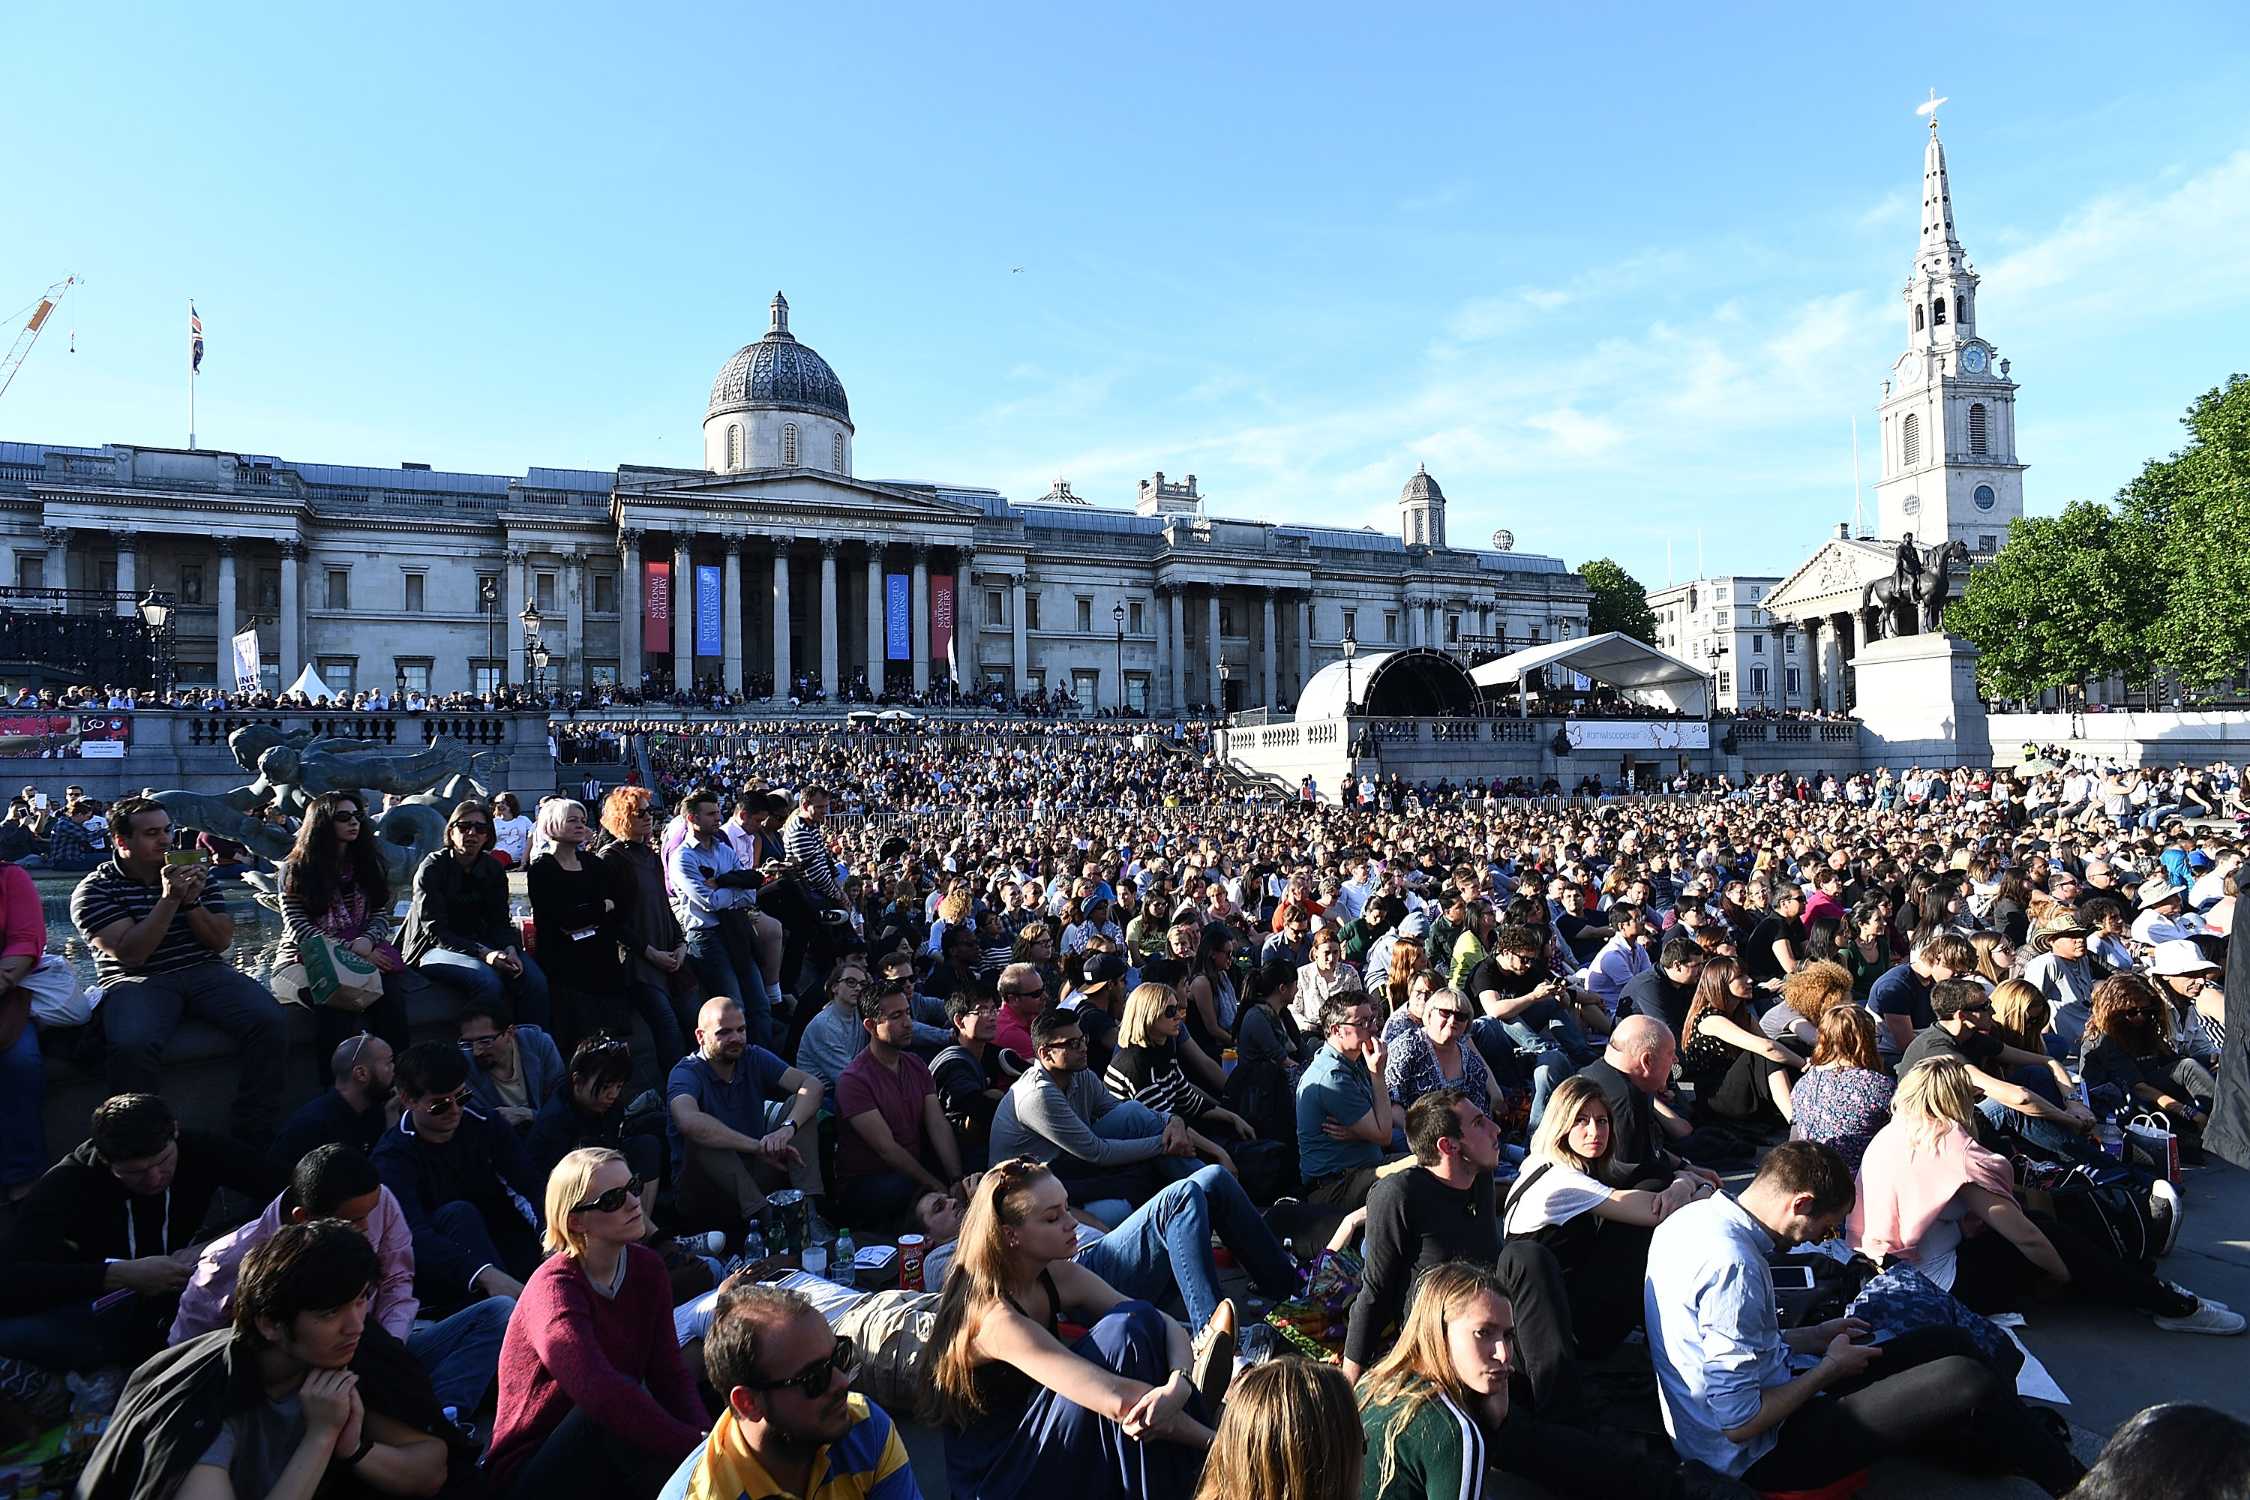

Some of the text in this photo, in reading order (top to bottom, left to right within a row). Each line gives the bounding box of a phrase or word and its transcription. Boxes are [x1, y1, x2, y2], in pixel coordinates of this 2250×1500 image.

[659, 576, 667, 619] GALLERY
[703, 572, 711, 641] MICHELANGELO
[711, 584, 719, 635] SEBASTIANO
[892, 581, 900, 647] MICHELANGELO
[943, 588, 951, 629] GALLERY
[82, 718, 105, 732] LSO
